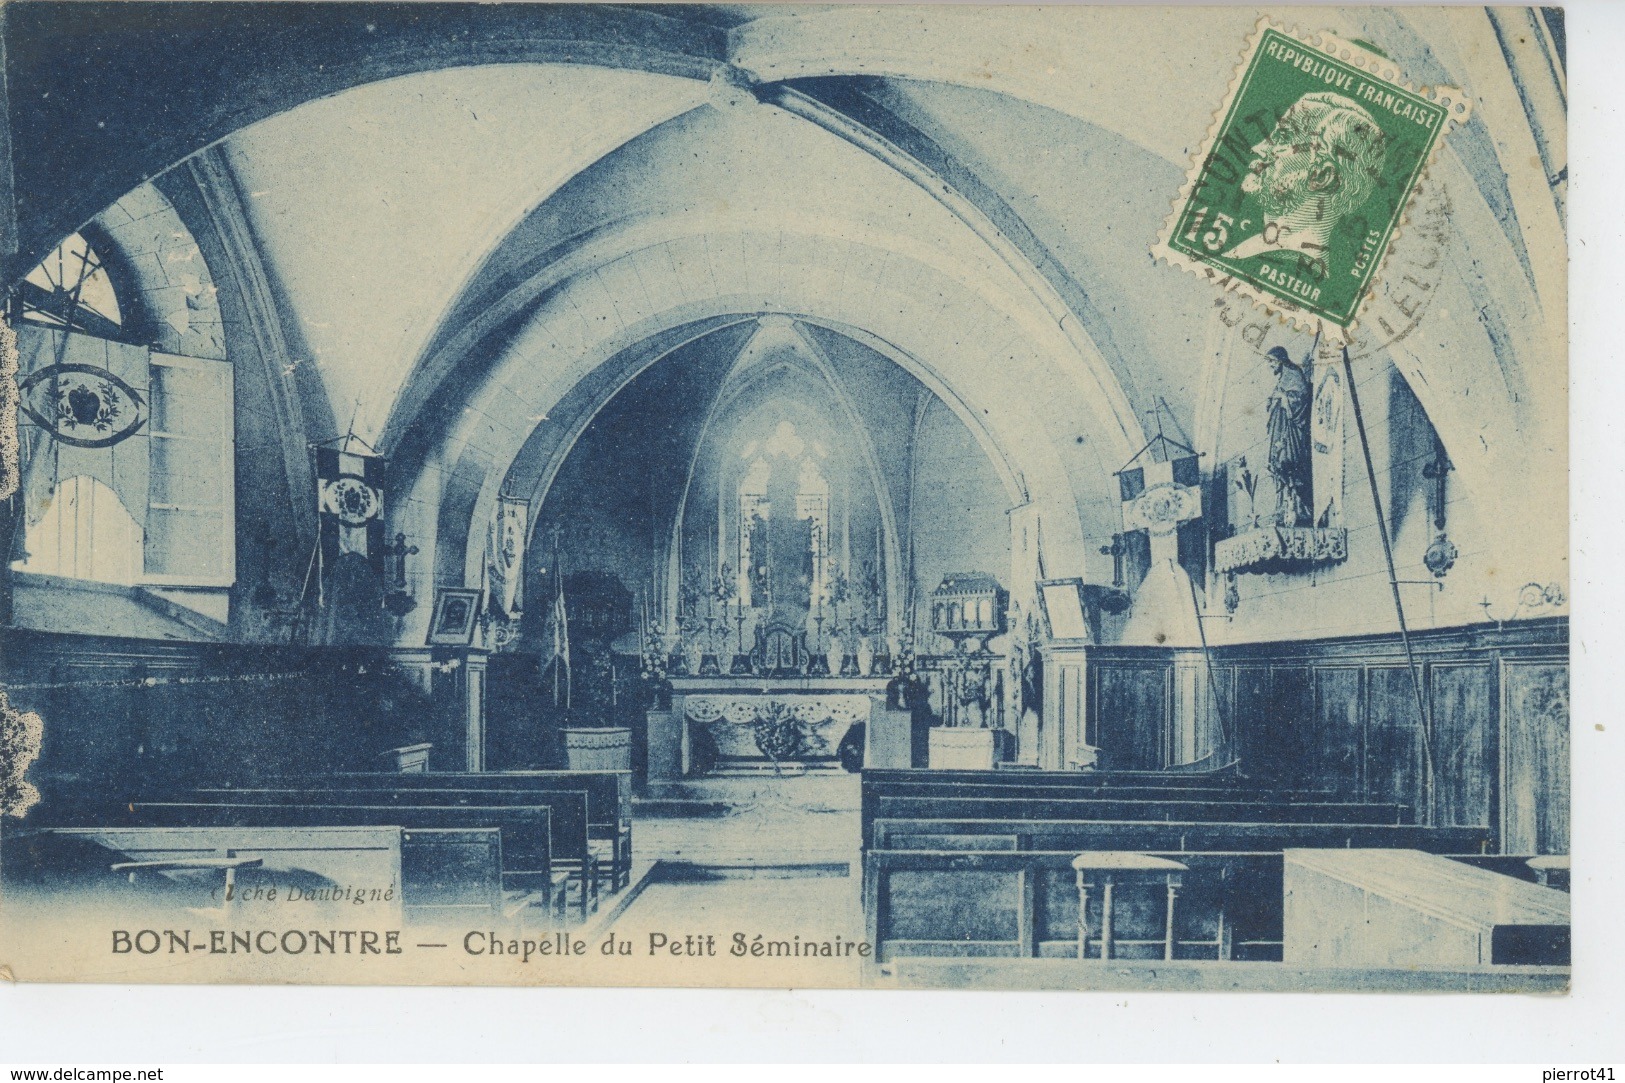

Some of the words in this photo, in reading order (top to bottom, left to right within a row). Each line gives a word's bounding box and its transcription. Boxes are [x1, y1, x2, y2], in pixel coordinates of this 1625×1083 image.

[1351, 229, 1380, 278] POSTES
[1259, 264, 1321, 301] PASTEUR
[286, 883, 394, 905] Daubigné
[111, 929, 403, 955] BON-ENCONTRE
[463, 931, 587, 963] Chapelle
[600, 932, 632, 956] du
[649, 932, 717, 957] Petit
[730, 933, 873, 957] Séminaire
